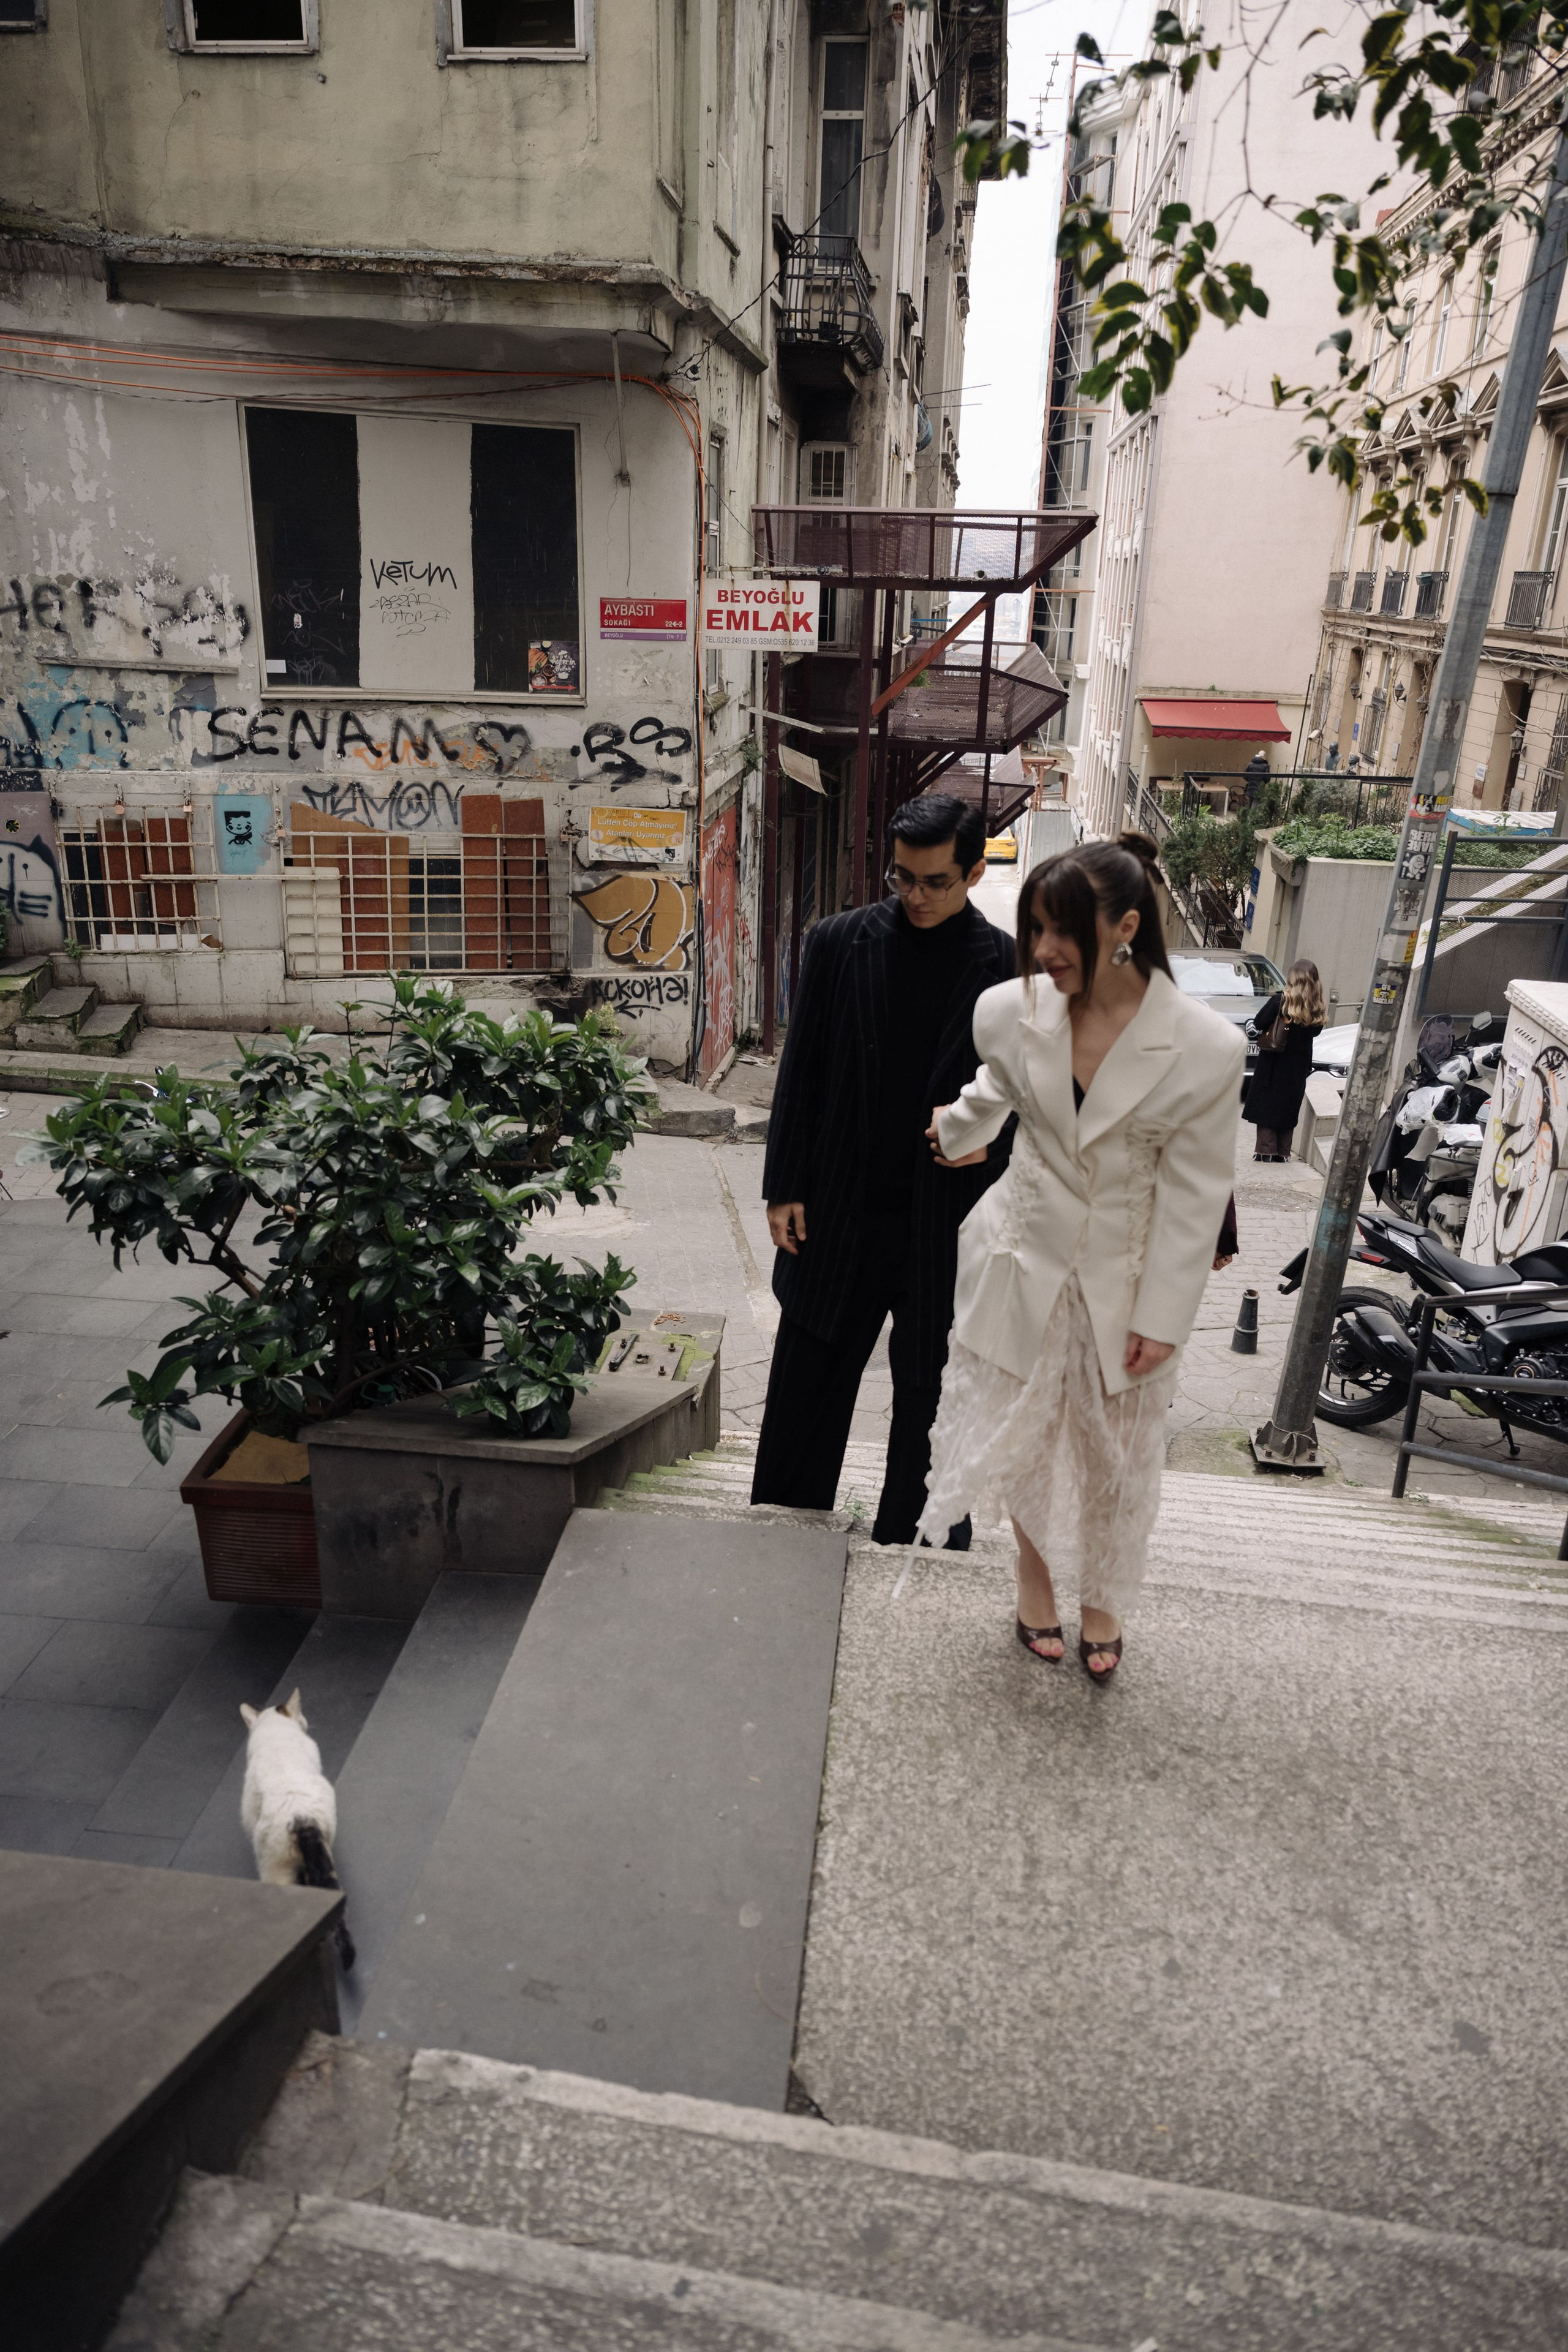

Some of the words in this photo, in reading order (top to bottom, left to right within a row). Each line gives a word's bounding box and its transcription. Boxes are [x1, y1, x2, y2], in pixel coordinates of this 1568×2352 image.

[717, 587, 804, 605] BEYOĞLU
[604, 604, 654, 616] AYBASTI
[706, 609, 814, 633] EMLAK
[597, 818, 621, 826] Lütfen
[622, 819, 638, 828] Çöp
[639, 821, 677, 829] Atmayınız!
